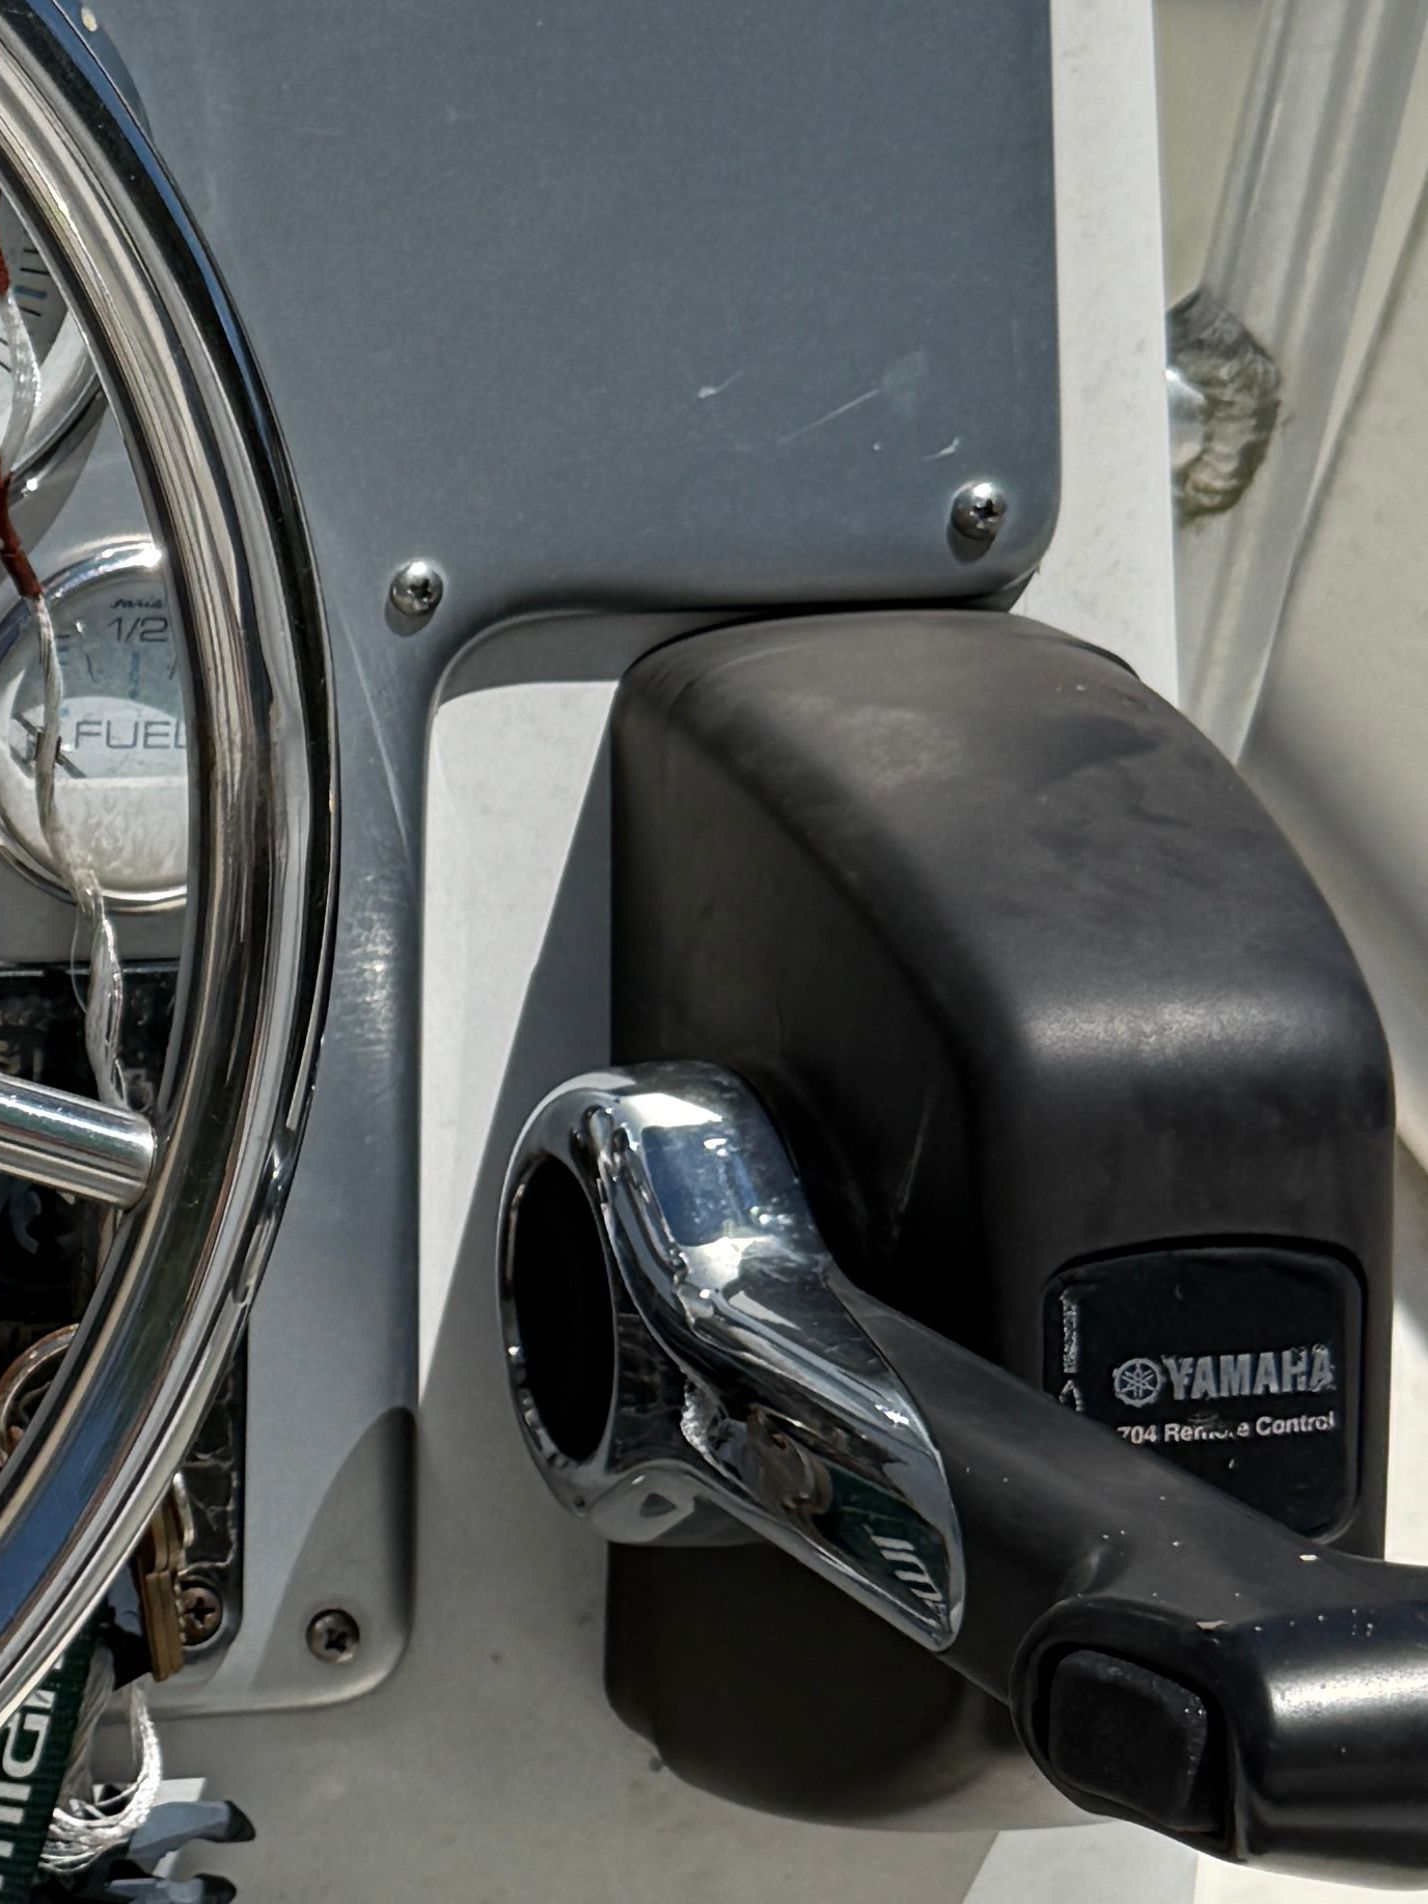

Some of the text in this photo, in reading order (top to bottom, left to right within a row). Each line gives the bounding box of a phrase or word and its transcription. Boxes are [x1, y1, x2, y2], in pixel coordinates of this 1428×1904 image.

[107, 616, 169, 643] 1/2
[75, 719, 187, 751] FUEL
[1161, 1342, 1336, 1401] YAMAHA
[1164, 1421, 1250, 1442] Reme
[1256, 1410, 1336, 1437] Control
